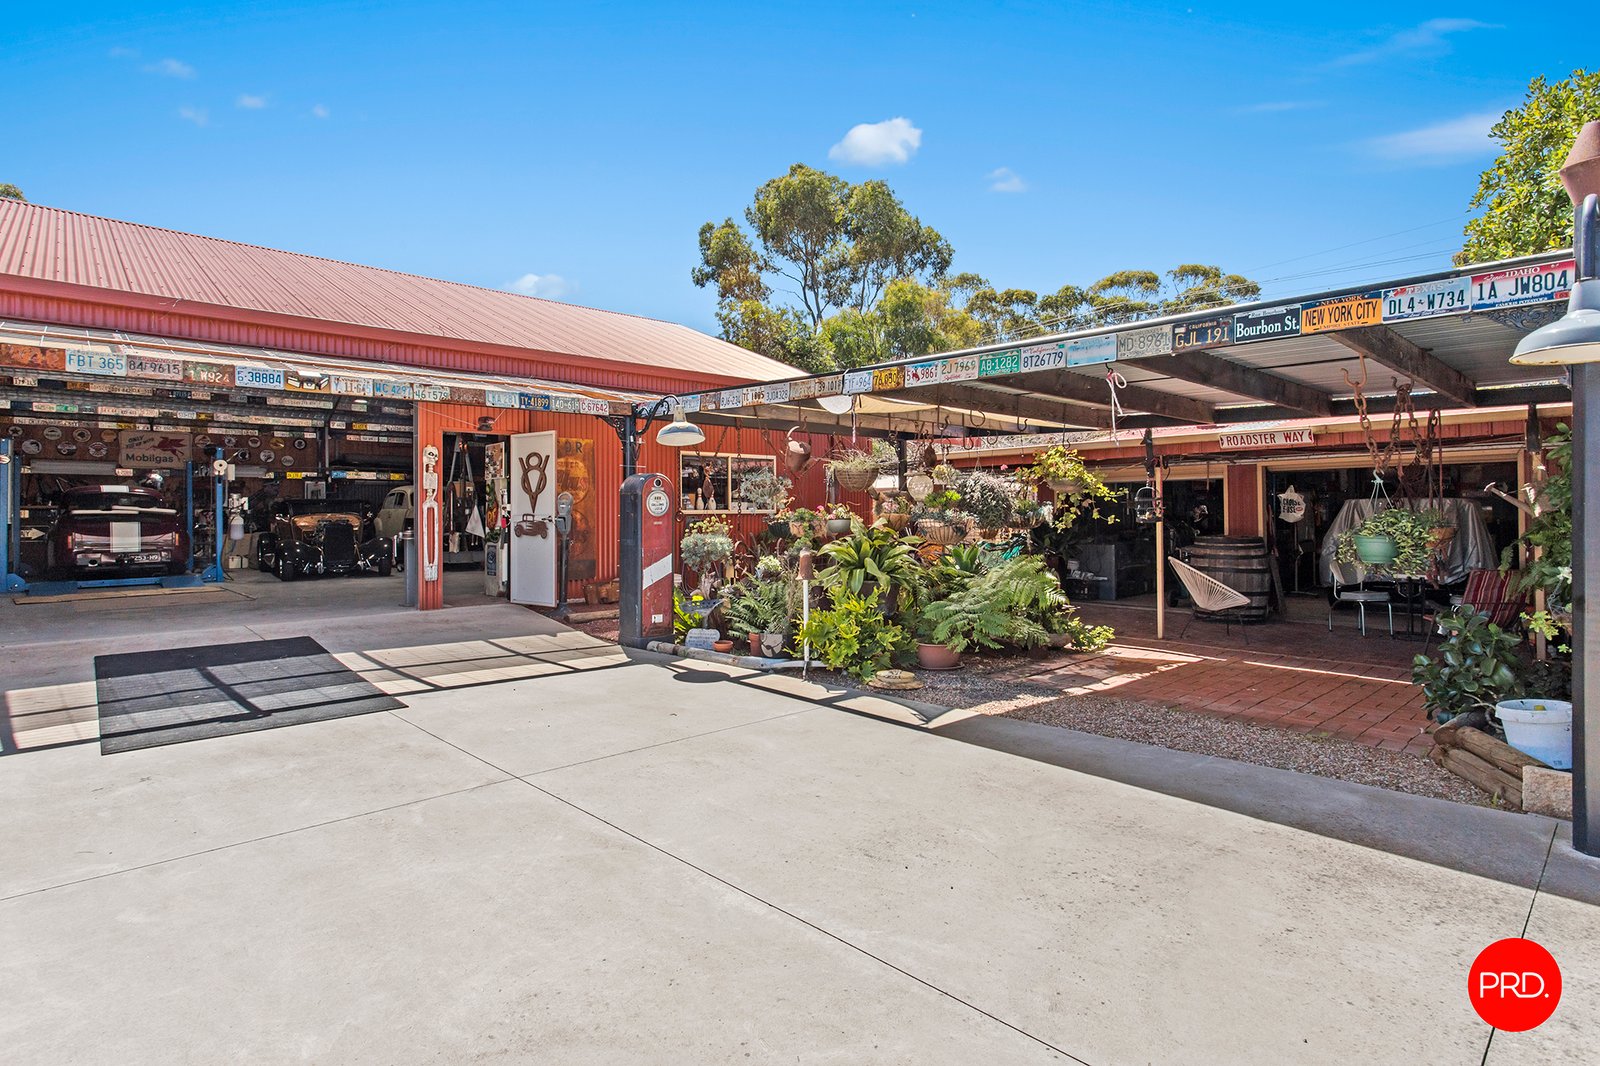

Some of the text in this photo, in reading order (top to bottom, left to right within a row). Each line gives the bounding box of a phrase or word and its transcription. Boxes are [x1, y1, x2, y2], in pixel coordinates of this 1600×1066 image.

[1505, 266, 1541, 278] IDAHO
[1406, 284, 1444, 295] TEXAS
[1508, 269, 1569, 297] JW804
[1341, 294, 1363, 303] YORK
[1304, 300, 1378, 328] NEW YORK CITY
[1236, 315, 1300, 339] Bourbon St.
[1175, 326, 1229, 348] GJL 191
[68, 354, 124, 371] FBT 365
[1022, 351, 1064, 369] 8T26779
[1226, 431, 1304, 446] ROADSTER WAY
[126, 453, 174, 464] Mobilgas
